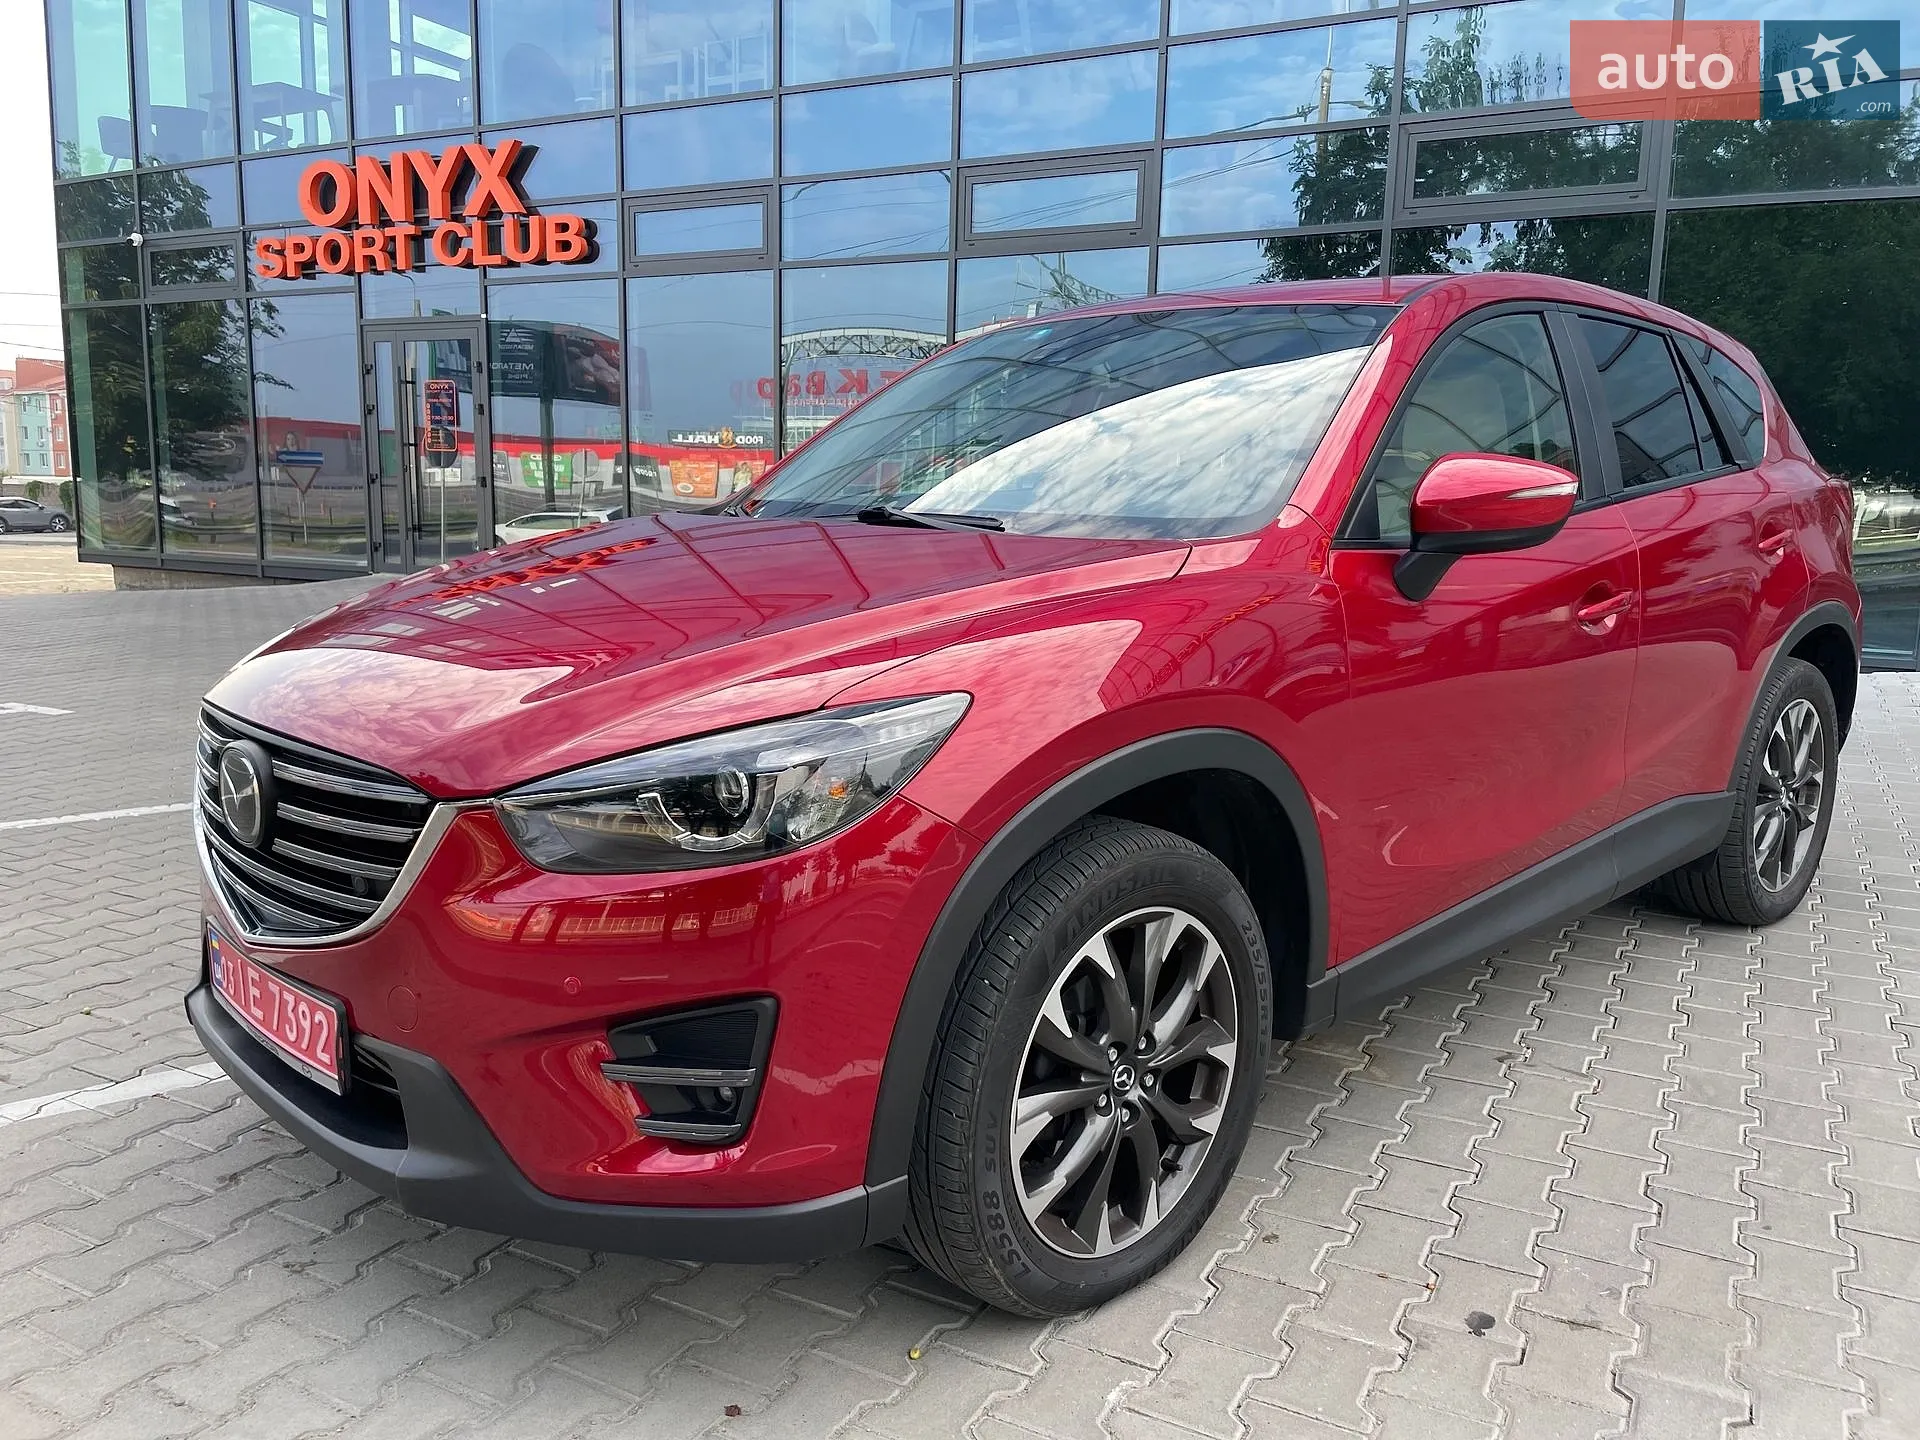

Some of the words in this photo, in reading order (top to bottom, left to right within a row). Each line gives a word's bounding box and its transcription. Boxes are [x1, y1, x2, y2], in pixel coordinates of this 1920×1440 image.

[298, 139, 525, 228] ONYX
[255, 224, 422, 279] SPORT
[432, 213, 590, 267] CLUB
[268, 981, 332, 1066] 7392
[984, 1110, 999, 1174] SUV
[983, 1189, 1032, 1279] LS588
